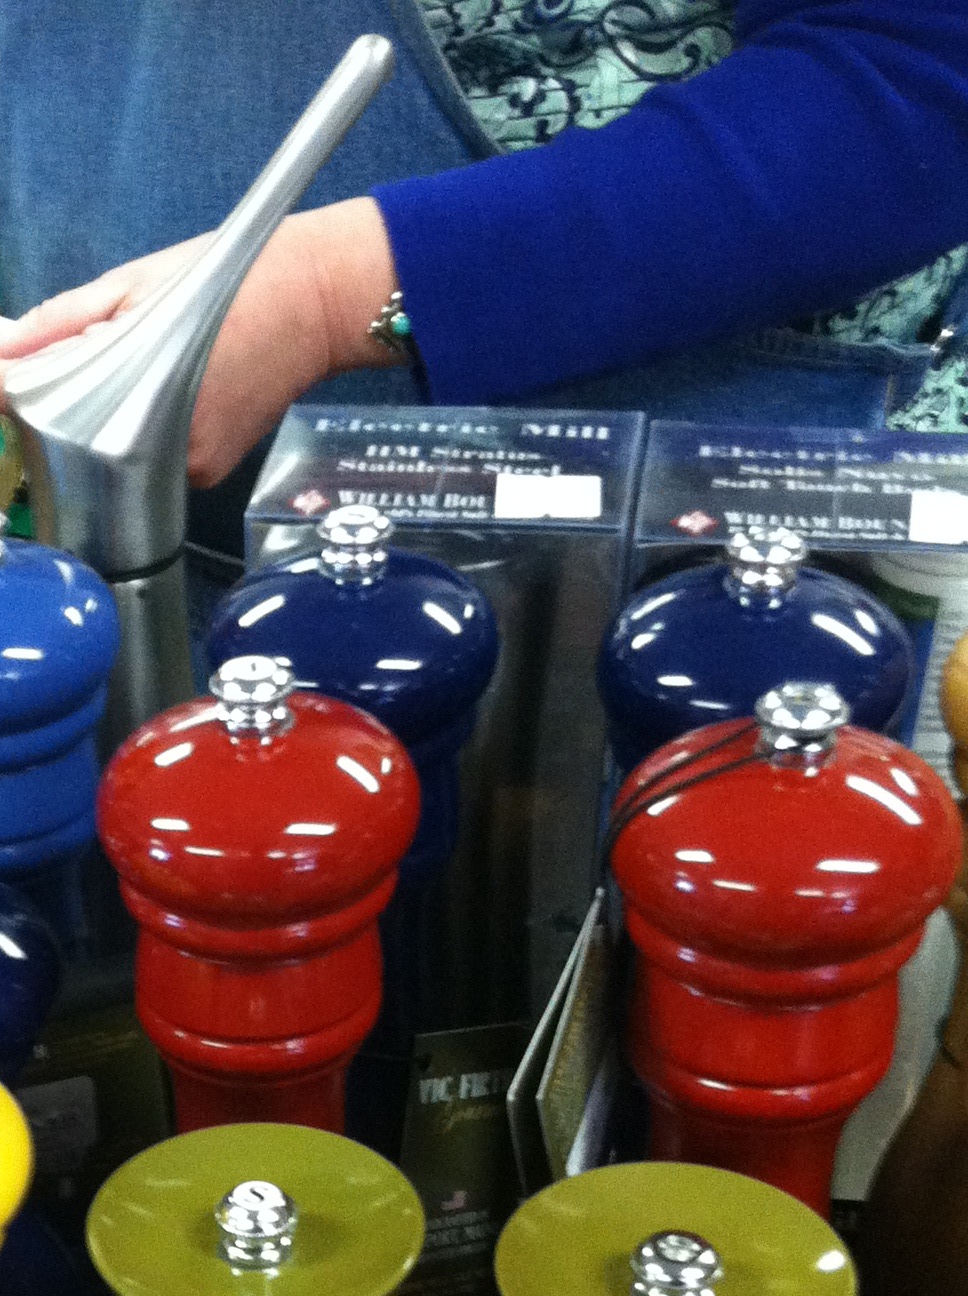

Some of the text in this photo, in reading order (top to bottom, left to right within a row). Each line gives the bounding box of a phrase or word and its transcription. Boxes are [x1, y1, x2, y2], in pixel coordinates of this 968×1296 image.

[521, 423, 610, 440] Mill
[338, 490, 438, 508] WILLIAM
[724, 511, 832, 529] WILLIAM
